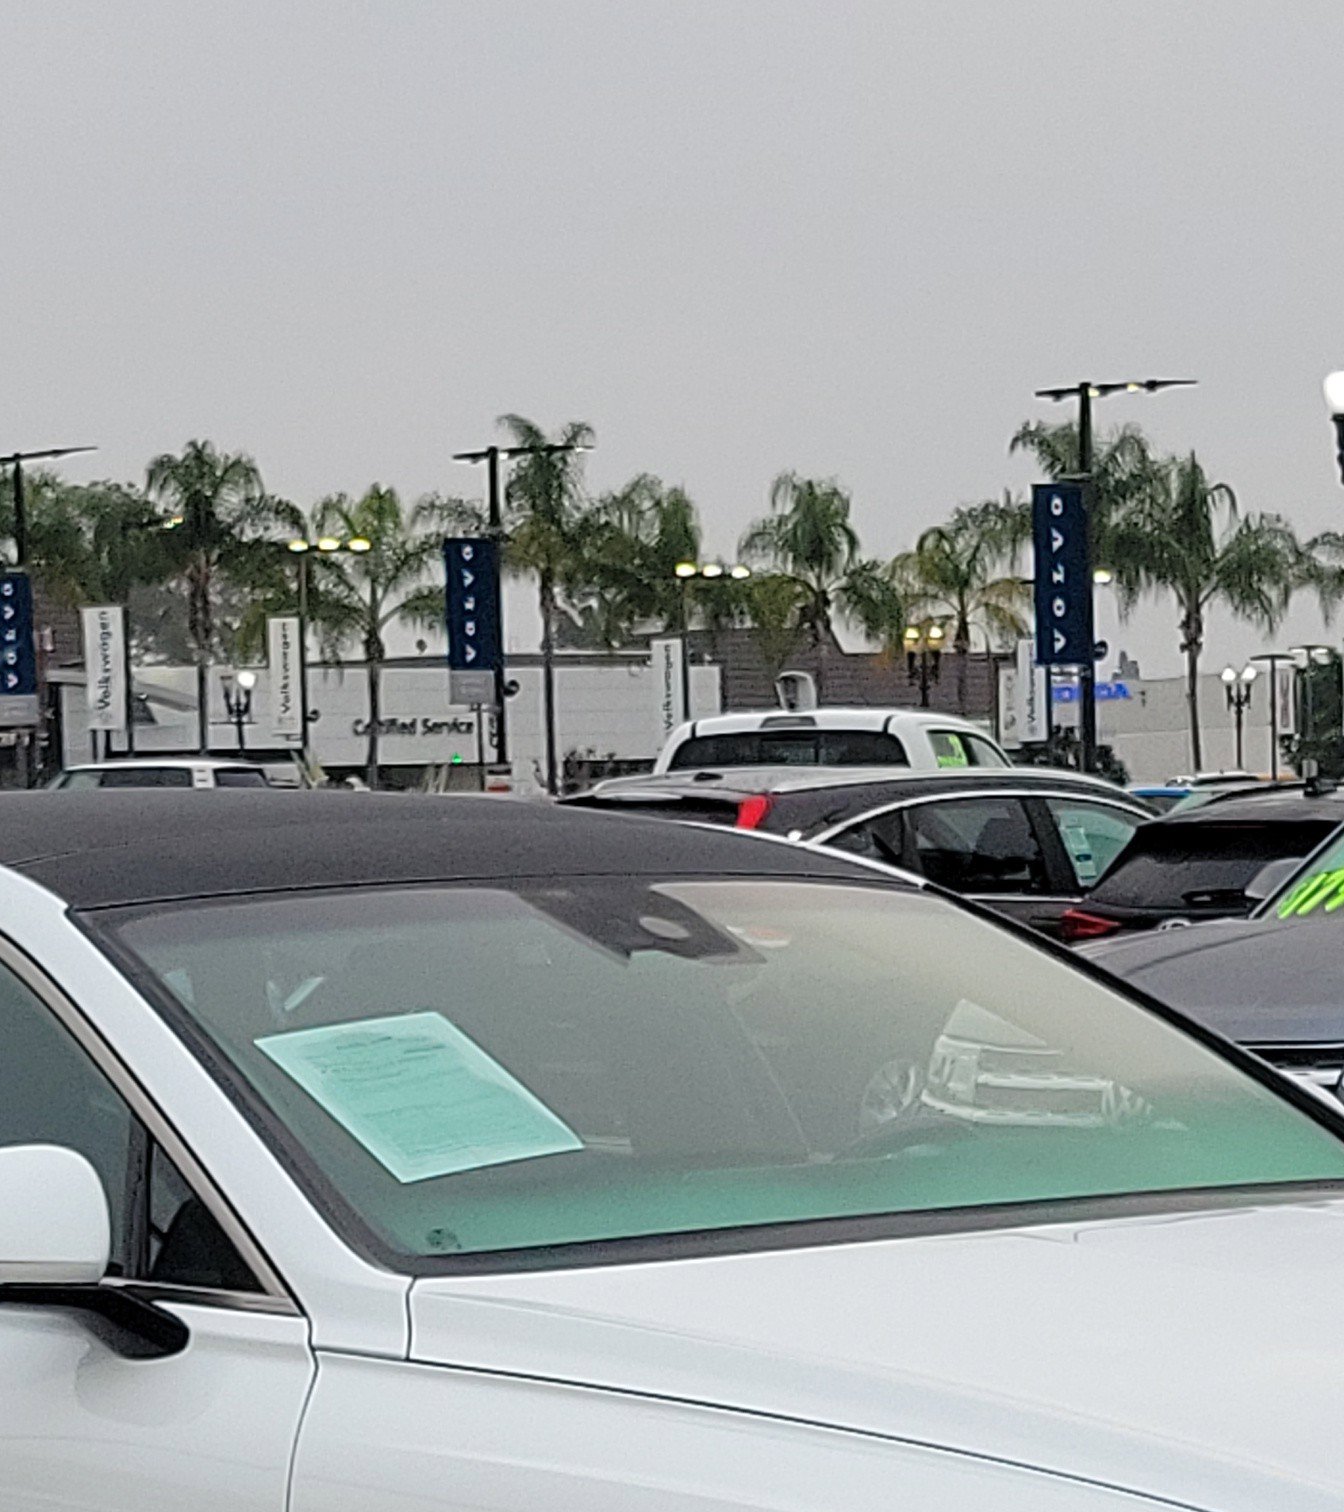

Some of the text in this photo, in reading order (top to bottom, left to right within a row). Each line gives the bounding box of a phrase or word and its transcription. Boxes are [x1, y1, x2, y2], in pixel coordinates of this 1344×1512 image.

[460, 544, 477, 664] VOLVO
[1050, 495, 1067, 654] VOLVO
[0, 582, 19, 689] VOLVO
[97, 610, 113, 710] Volkswagen
[280, 622, 291, 714] Volkswagen
[421, 717, 475, 737] Service
